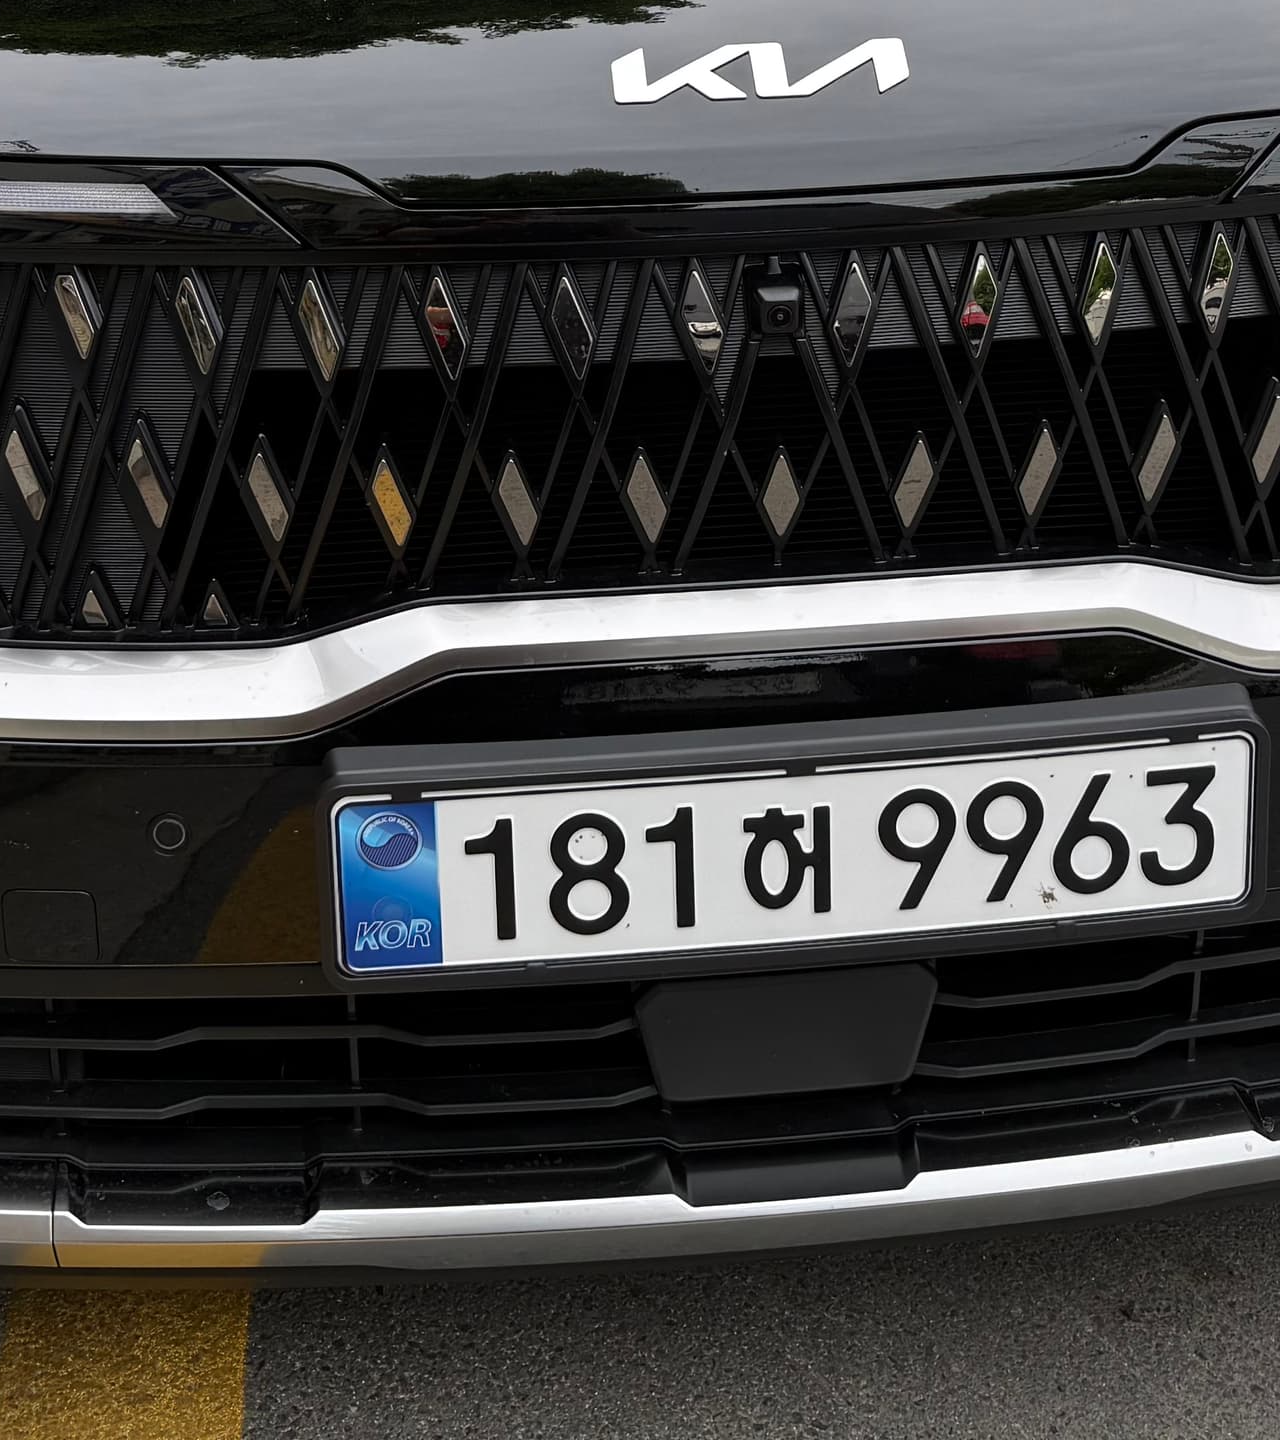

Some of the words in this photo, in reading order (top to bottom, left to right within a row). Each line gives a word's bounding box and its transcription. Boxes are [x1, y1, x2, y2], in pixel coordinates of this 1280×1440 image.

[610, 37, 910, 105] KIA
[877, 764, 1217, 911] 9963
[354, 918, 433, 952] KOR
